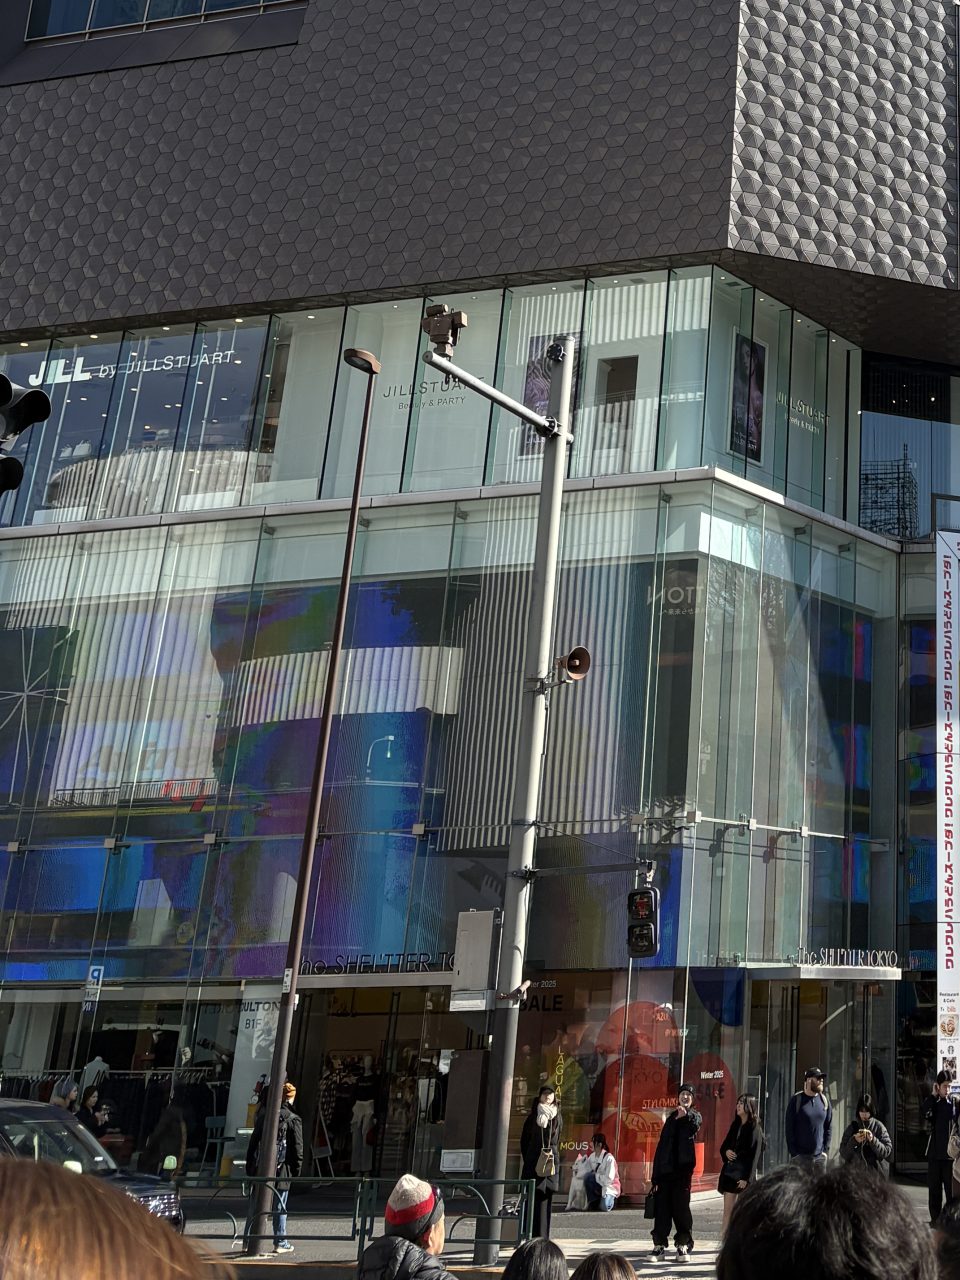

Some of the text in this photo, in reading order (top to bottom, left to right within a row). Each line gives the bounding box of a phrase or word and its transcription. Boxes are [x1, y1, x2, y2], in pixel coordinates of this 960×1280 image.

[28, 350, 235, 387] JILL by JILLSTUART
[383, 377, 485, 398] JILLSTUA
[437, 396, 466, 406] PARTY
